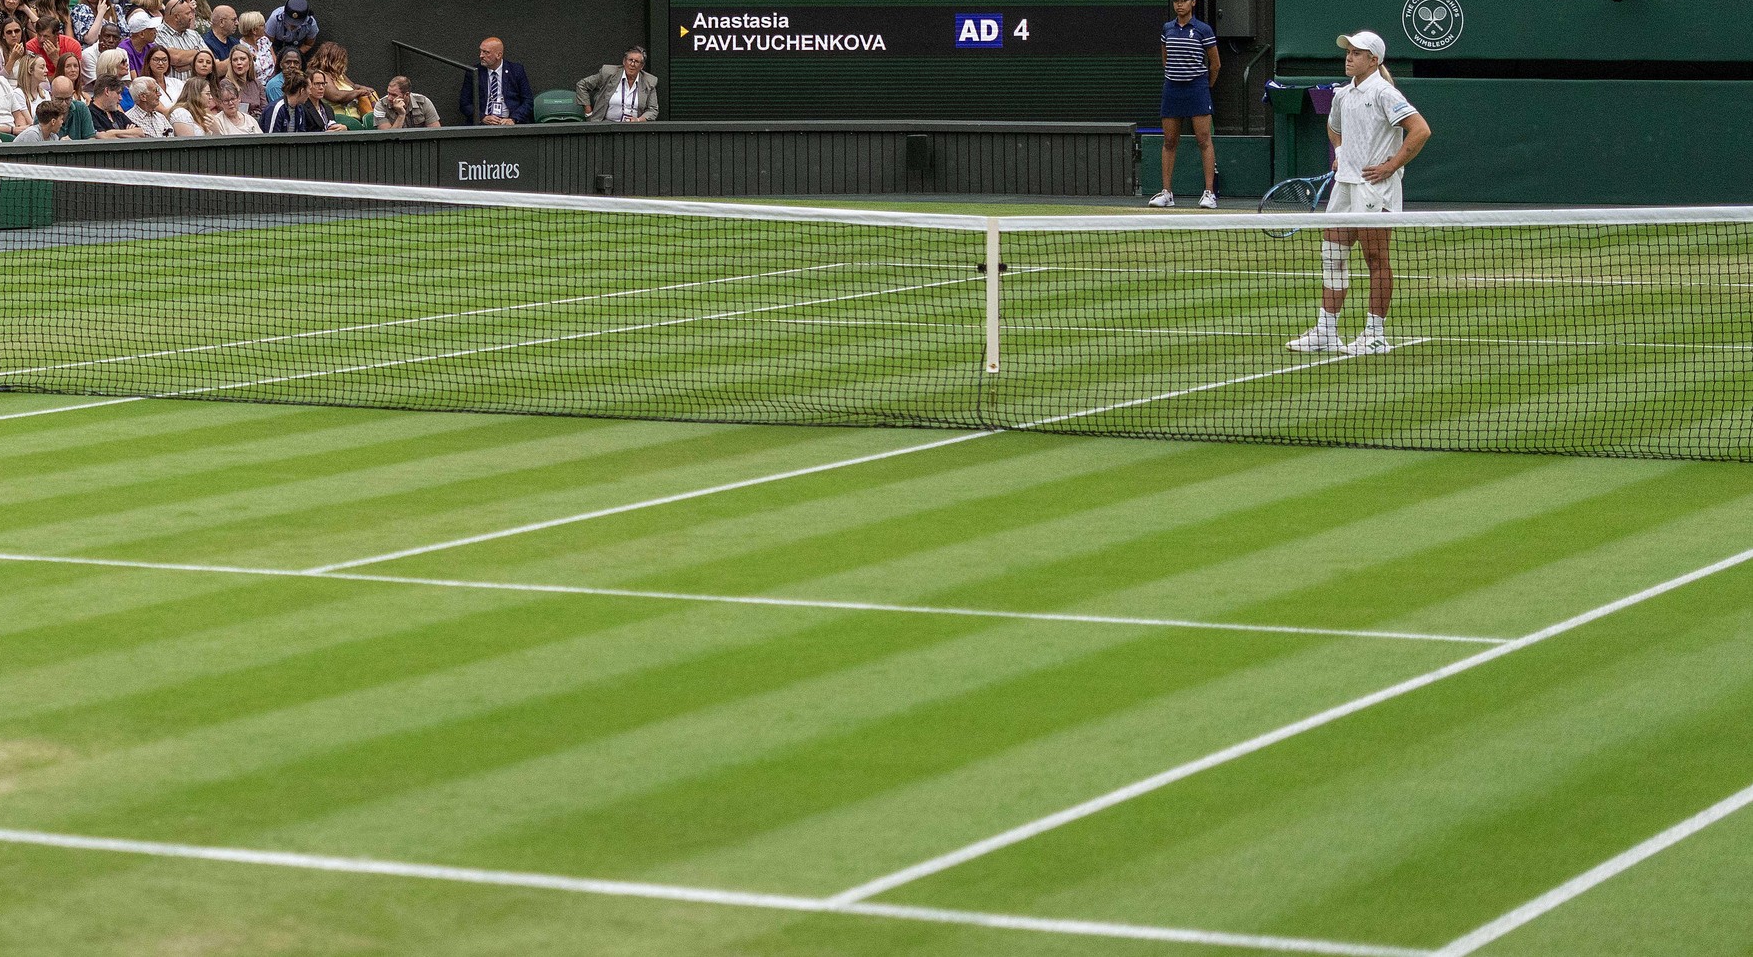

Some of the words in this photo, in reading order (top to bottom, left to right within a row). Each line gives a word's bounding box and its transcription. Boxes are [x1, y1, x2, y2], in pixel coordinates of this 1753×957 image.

[1406, 3, 1415, 18] THE
[692, 12, 789, 29] Anastasia
[959, 19, 999, 42] AD
[1013, 19, 1030, 41] 4
[694, 35, 886, 51] PAVLYUCHENKOVA
[1414, 33, 1454, 48] WIMBLEDON
[458, 159, 520, 181] Emirates
